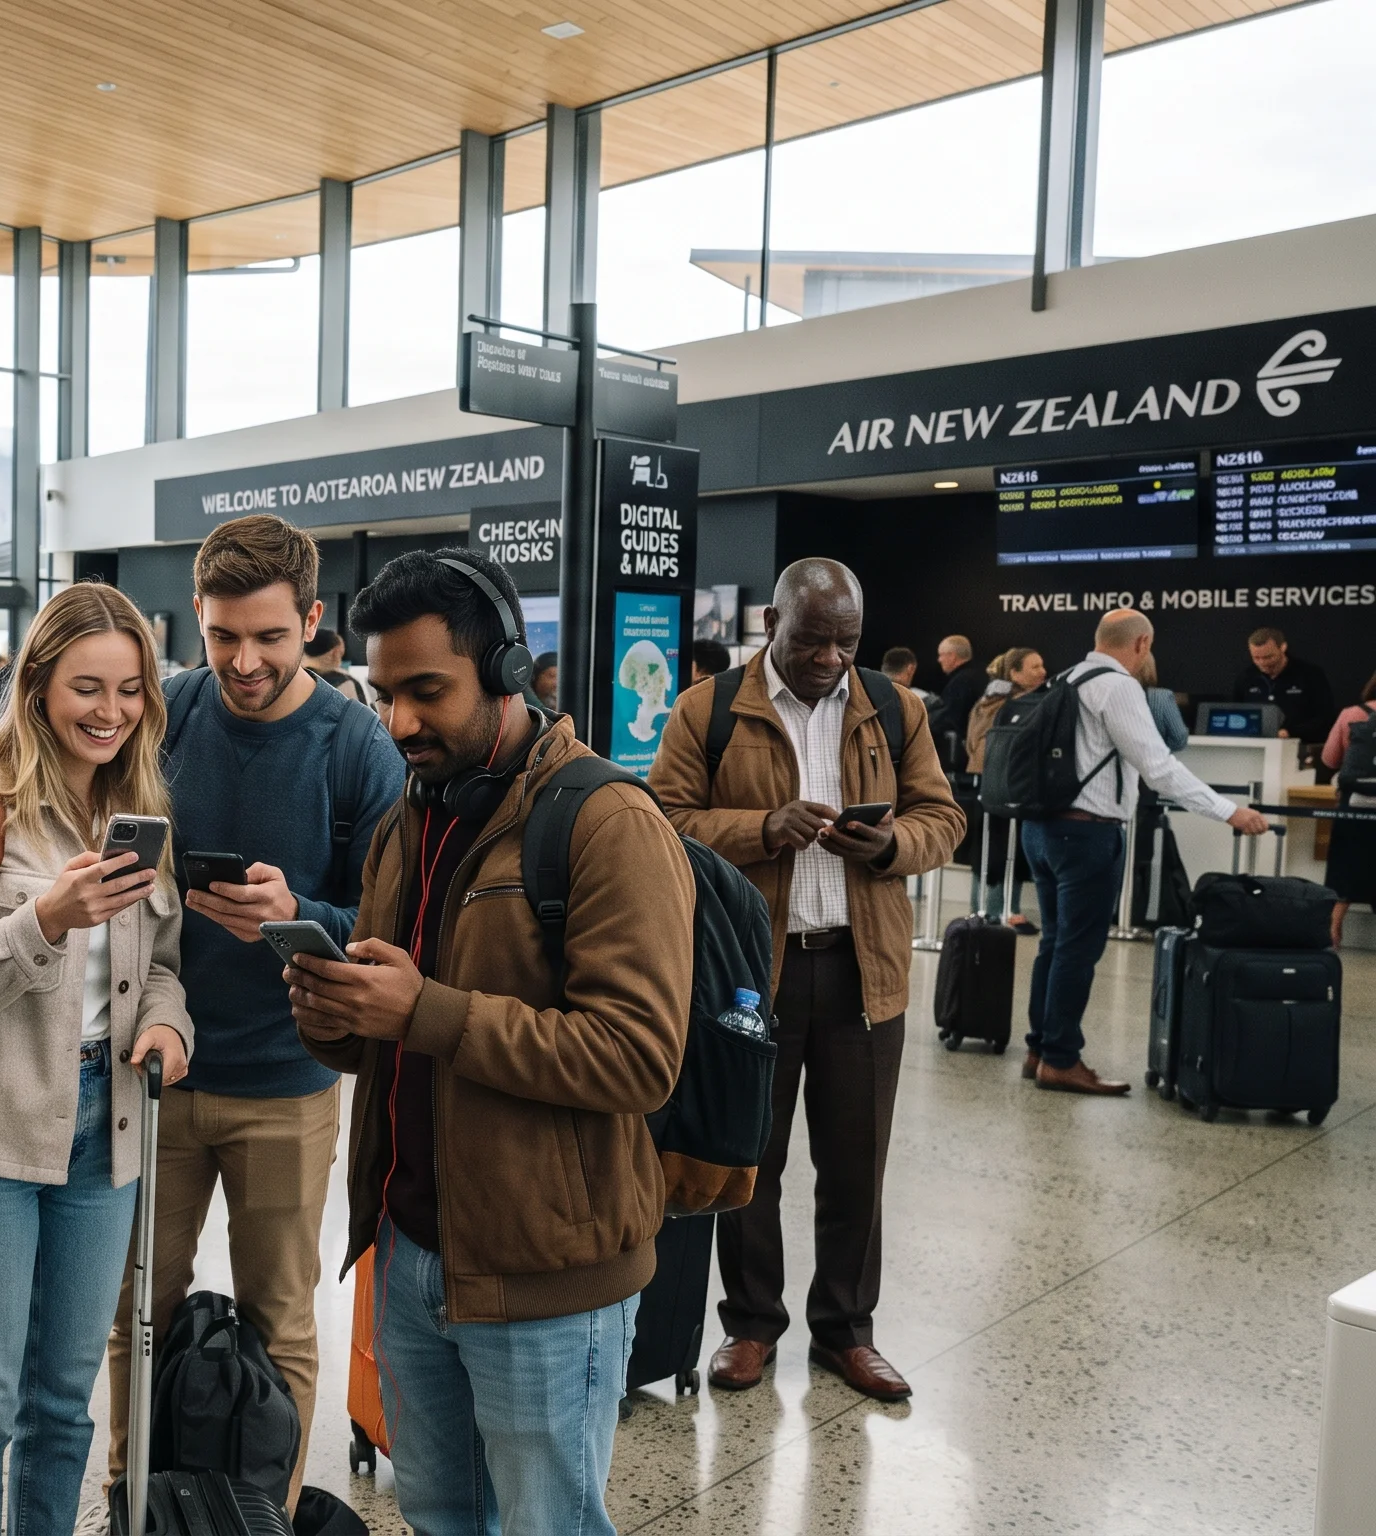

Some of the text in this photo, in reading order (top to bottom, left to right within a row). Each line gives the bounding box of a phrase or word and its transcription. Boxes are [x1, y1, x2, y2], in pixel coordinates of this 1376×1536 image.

[827, 377, 1241, 456] AIR NEW ZEALAND
[201, 455, 545, 515] WELCOME TO AOTEAROA NEW ZEALAND
[478, 518, 563, 543] CHECK-IN
[620, 503, 682, 531] DIGITAL
[489, 541, 554, 563] KIOSKS
[620, 529, 680, 555] GUIDES
[620, 554, 680, 578] & MAPS
[999, 583, 1376, 613] TRAVEL INFO & MOBILE SERVICES
